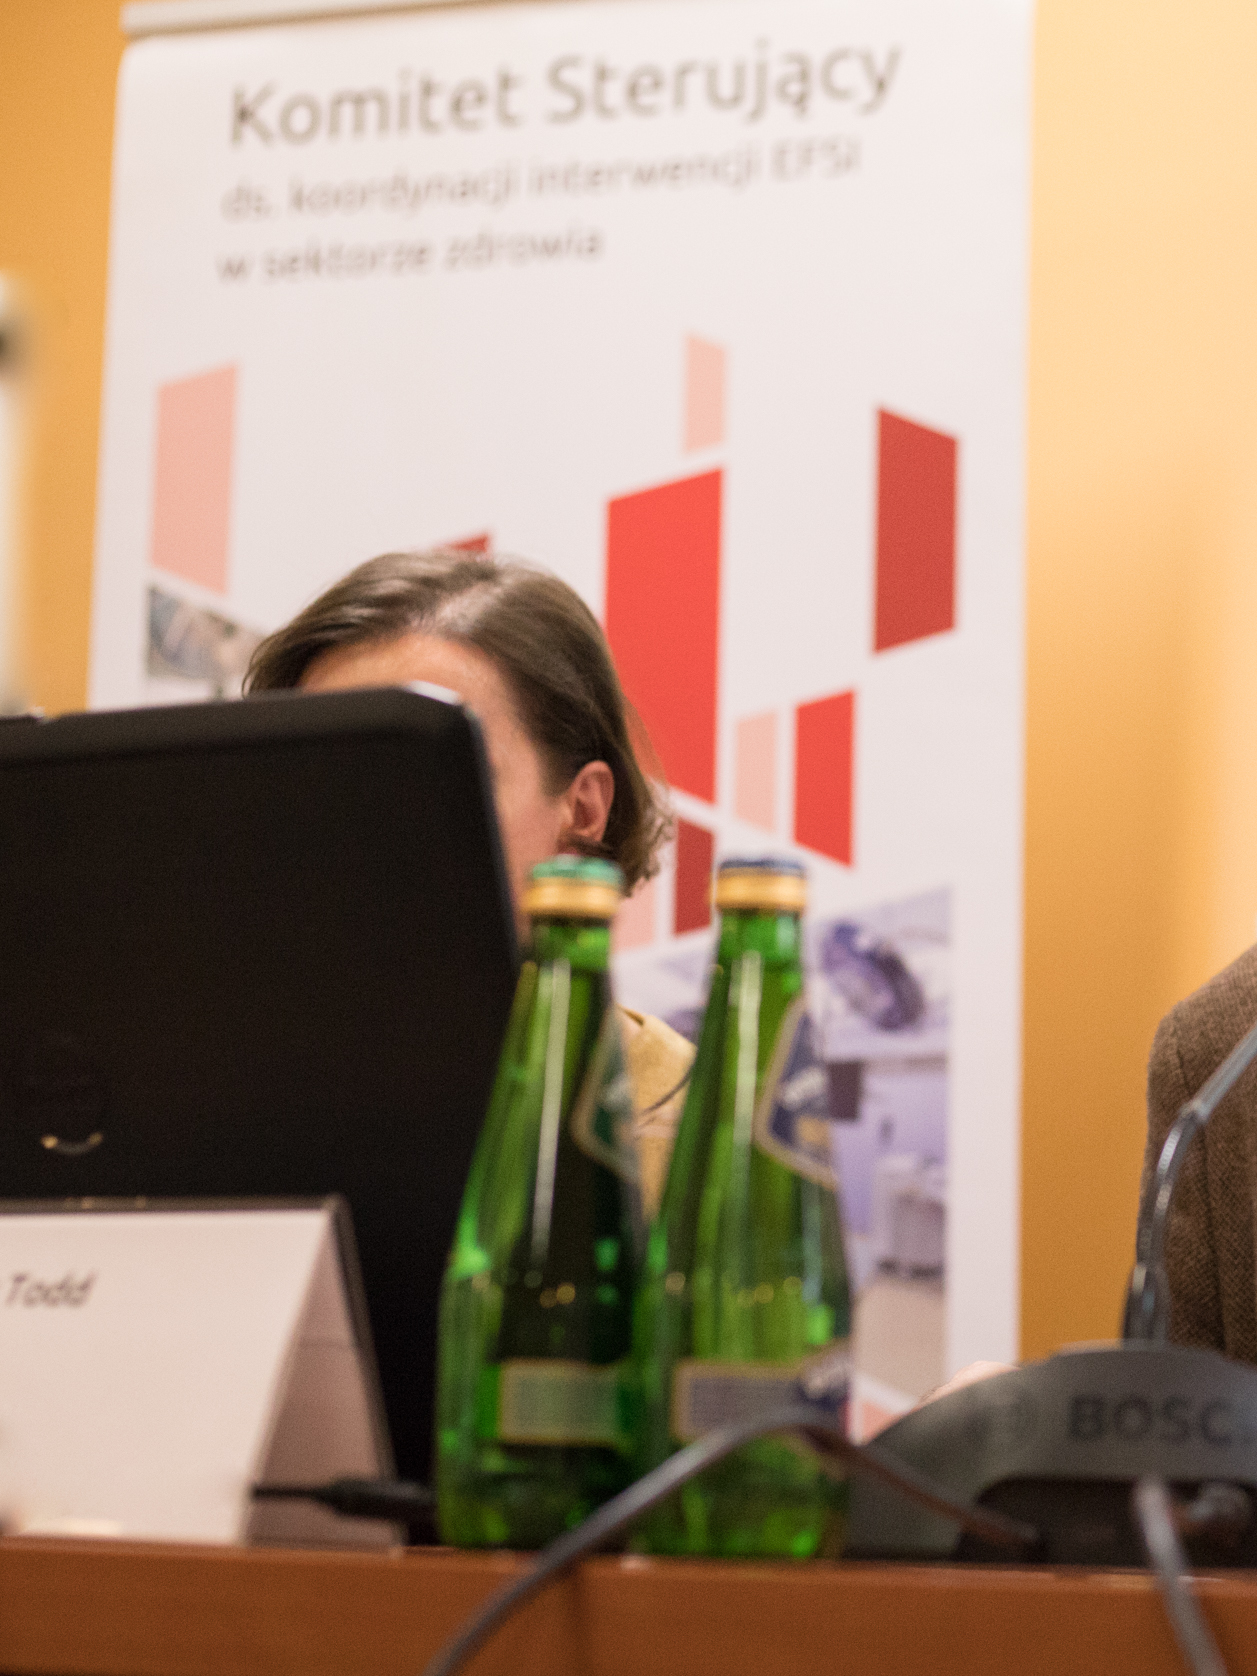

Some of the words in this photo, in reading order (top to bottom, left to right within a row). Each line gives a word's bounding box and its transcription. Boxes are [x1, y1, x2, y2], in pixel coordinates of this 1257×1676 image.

[228, 69, 524, 149] Komitet
[545, 38, 903, 126] Sterujący
[222, 180, 272, 220] ds.
[289, 164, 514, 216] koordynacji
[530, 140, 762, 193] interwencji
[771, 138, 861, 181] EFSI
[217, 256, 251, 282] w
[263, 237, 431, 280] sektorze
[443, 225, 604, 270] zdrowia
[7, 1270, 97, 1308] Todd
